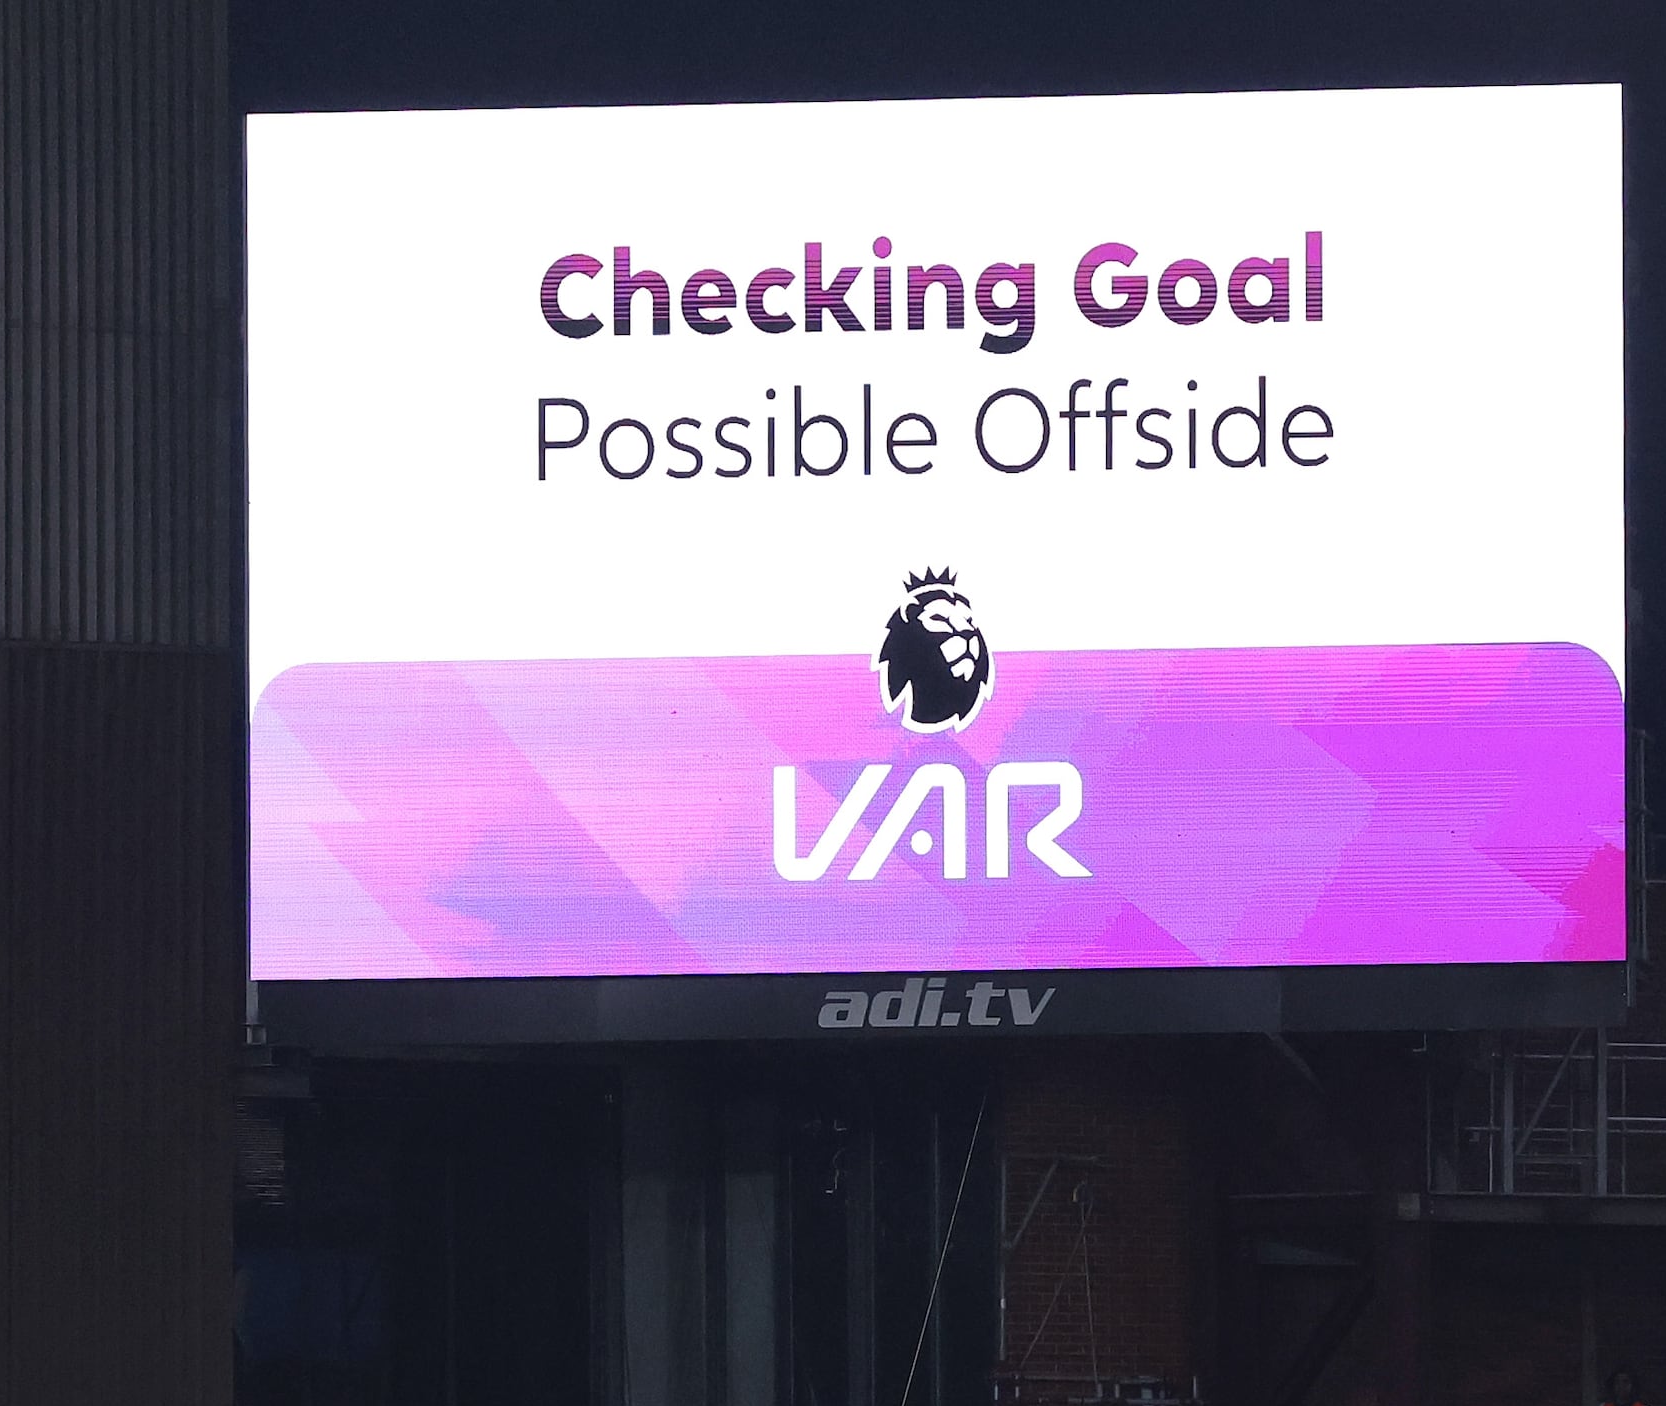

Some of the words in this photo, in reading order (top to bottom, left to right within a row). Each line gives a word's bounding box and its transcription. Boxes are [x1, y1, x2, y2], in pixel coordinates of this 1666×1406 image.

[540, 236, 1035, 354] Checking
[1074, 231, 1323, 328] Goal
[538, 384, 937, 481] Possible
[975, 376, 1333, 473] Offside
[773, 762, 1093, 881] VAR
[818, 978, 1056, 1027] adi.tv
